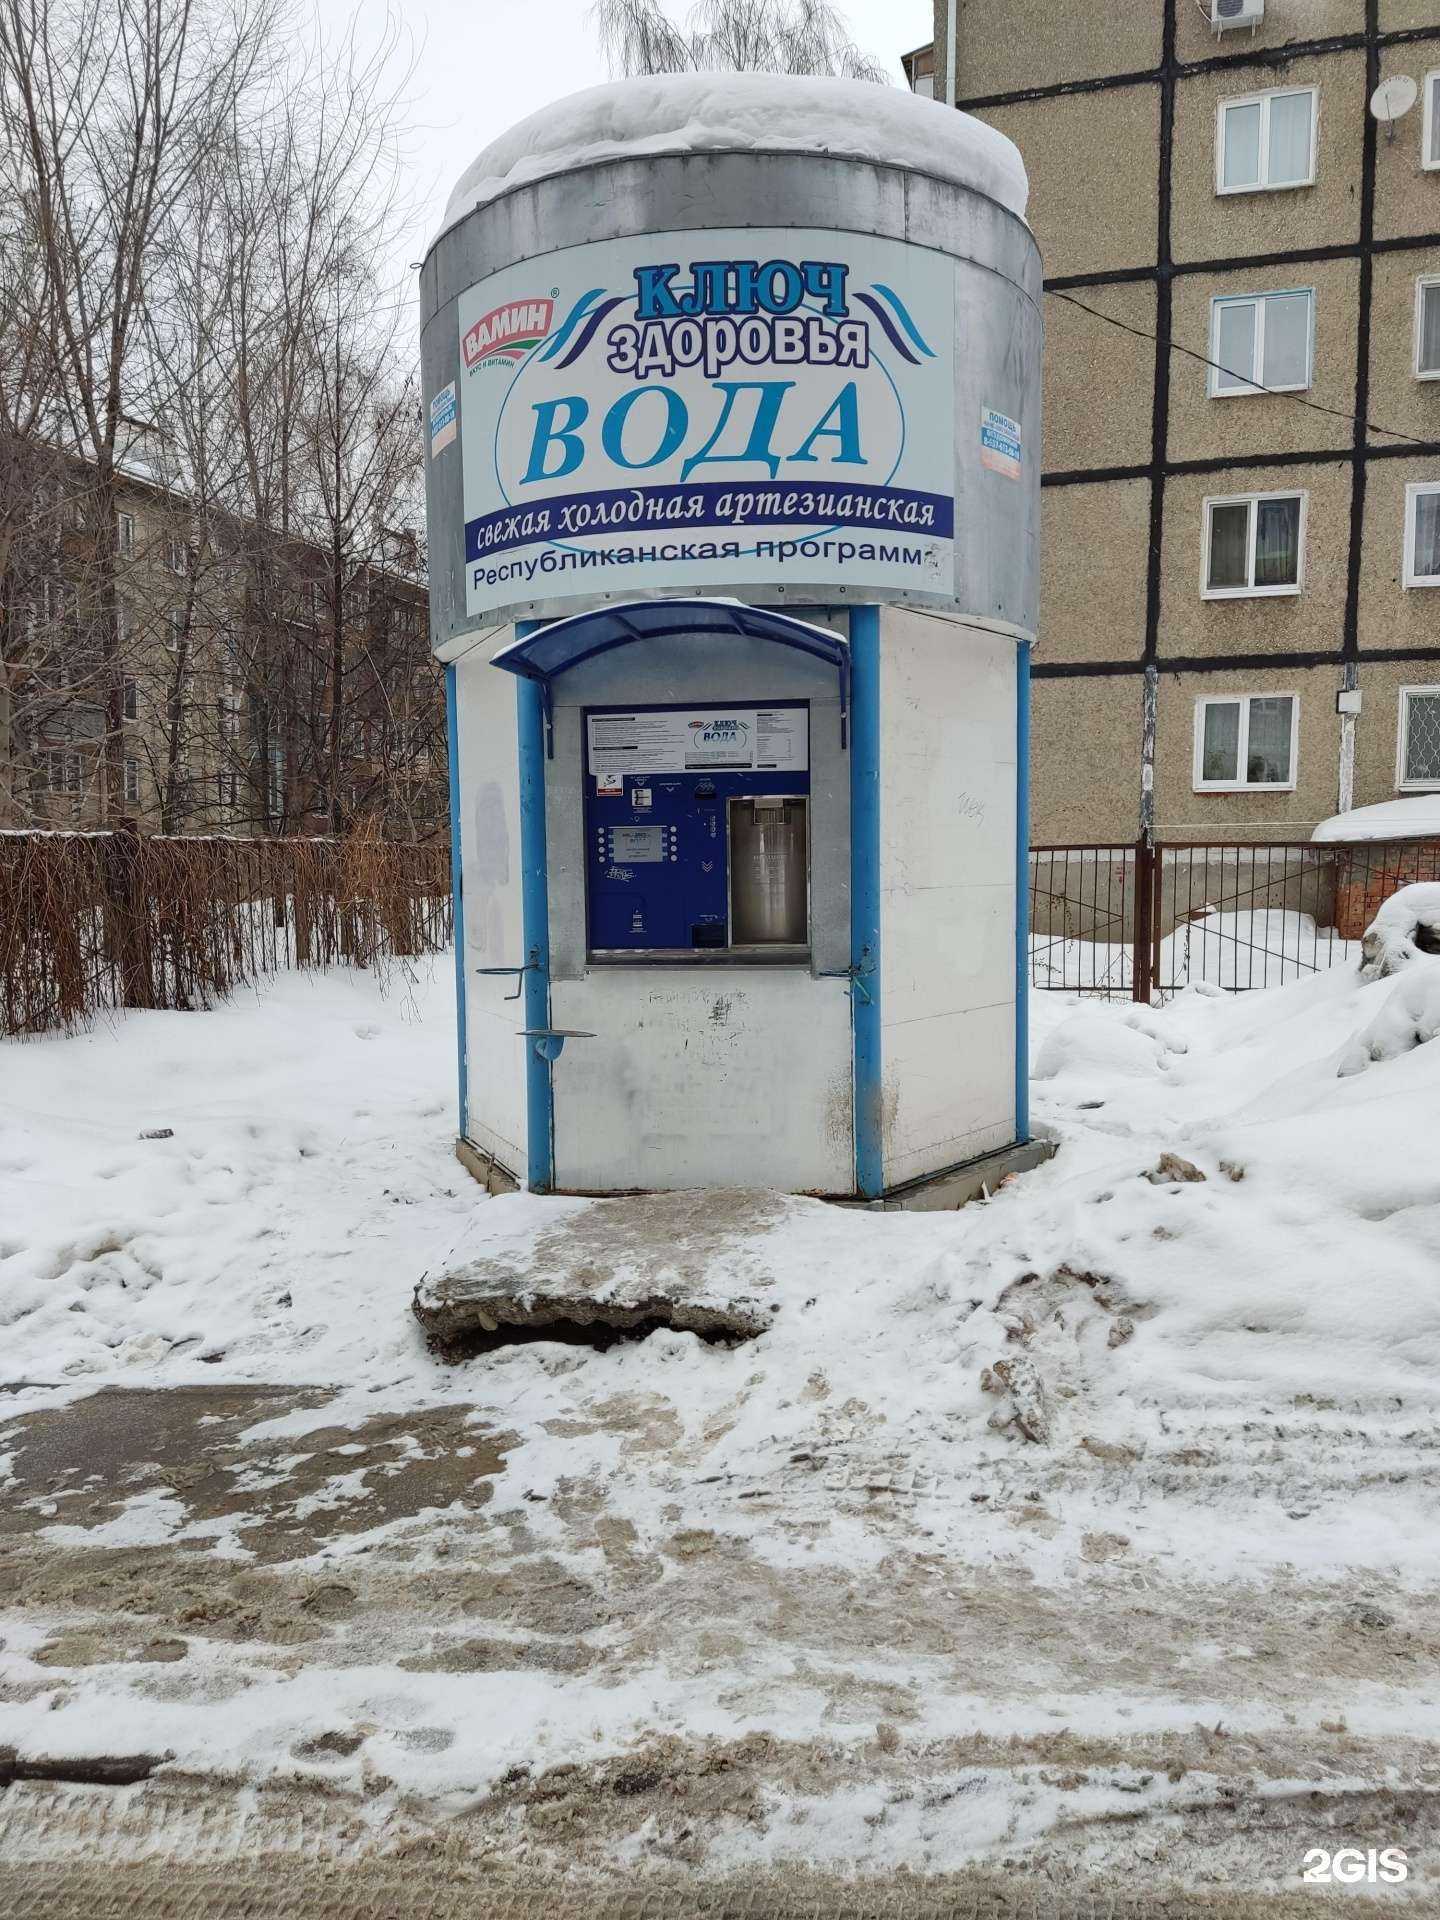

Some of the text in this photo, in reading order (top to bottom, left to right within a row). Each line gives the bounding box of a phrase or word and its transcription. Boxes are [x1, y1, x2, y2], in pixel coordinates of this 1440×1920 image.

[634, 260, 850, 321] КЛЮЧ
[466, 303, 548, 359] ВАМИН
[607, 317, 869, 379] ЗДОРОВЬЯ
[519, 381, 868, 486] ВОДА
[477, 490, 935, 550] свежая холодная артезианская
[474, 540, 939, 590] Республиканская программ
[704, 731, 737, 742] ВОДА
